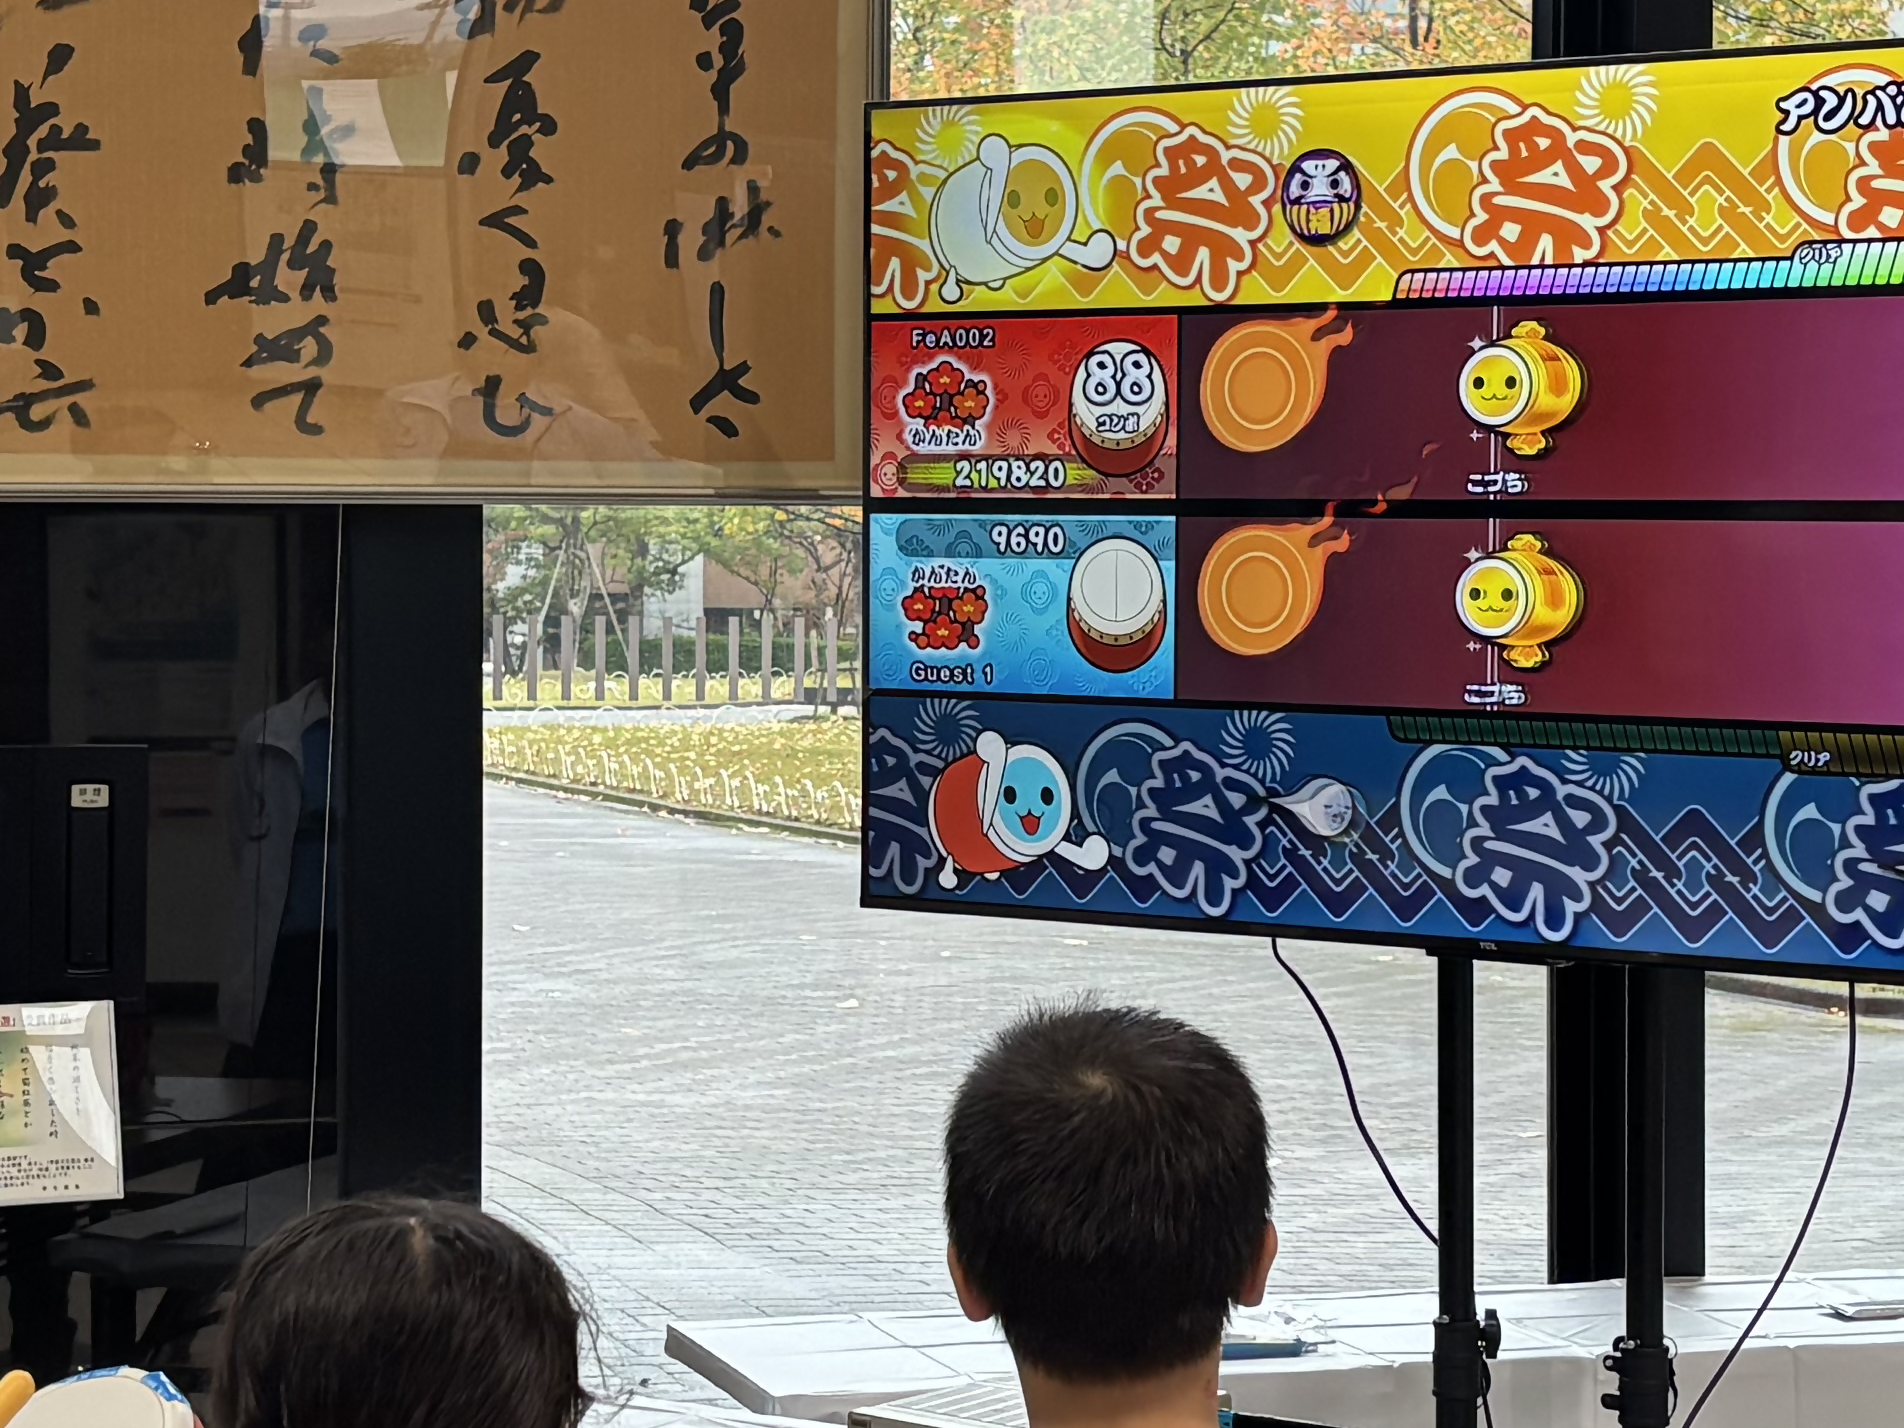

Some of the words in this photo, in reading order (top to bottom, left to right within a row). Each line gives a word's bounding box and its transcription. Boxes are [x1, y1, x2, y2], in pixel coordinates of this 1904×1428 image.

[1799, 244, 1843, 265] クリア
[911, 328, 994, 348] FeA002
[1083, 349, 1155, 406] 88
[1096, 413, 1140, 433] コンボ
[908, 425, 982, 448] かんたん
[954, 459, 1067, 489] 219820
[990, 523, 1066, 555] 9690
[911, 565, 978, 585] かんたん
[911, 662, 974, 684] Guest
[983, 664, 993, 684] 1
[1789, 749, 1832, 768] クリア
